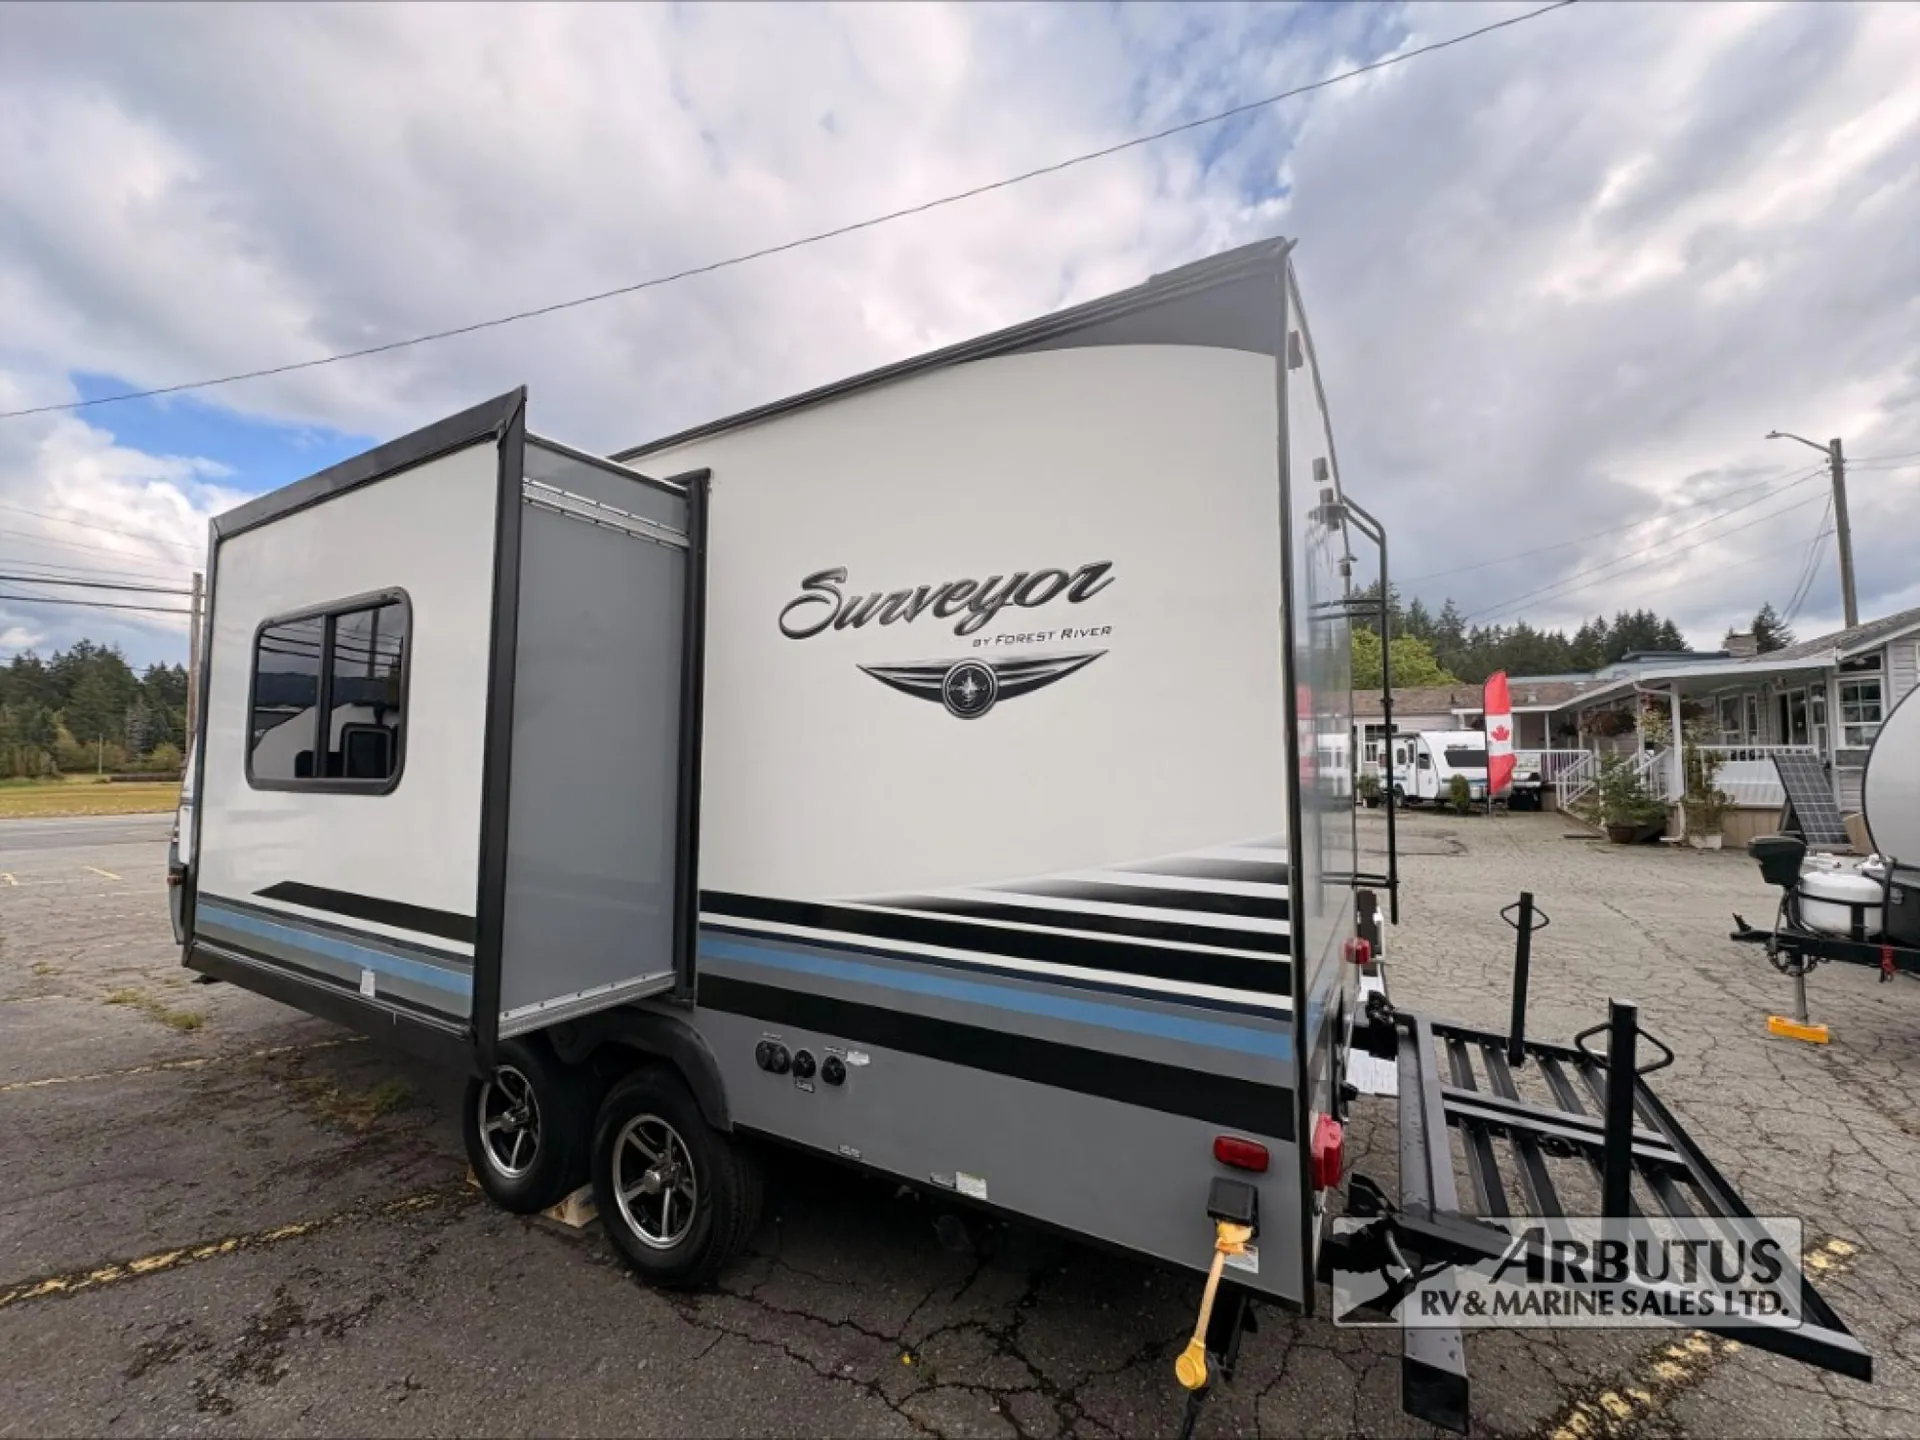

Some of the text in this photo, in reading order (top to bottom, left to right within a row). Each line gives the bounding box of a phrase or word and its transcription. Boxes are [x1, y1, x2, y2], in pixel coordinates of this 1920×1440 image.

[778, 560, 1116, 640] Surveyor
[972, 625, 1113, 648] BY FOREST RIVER
